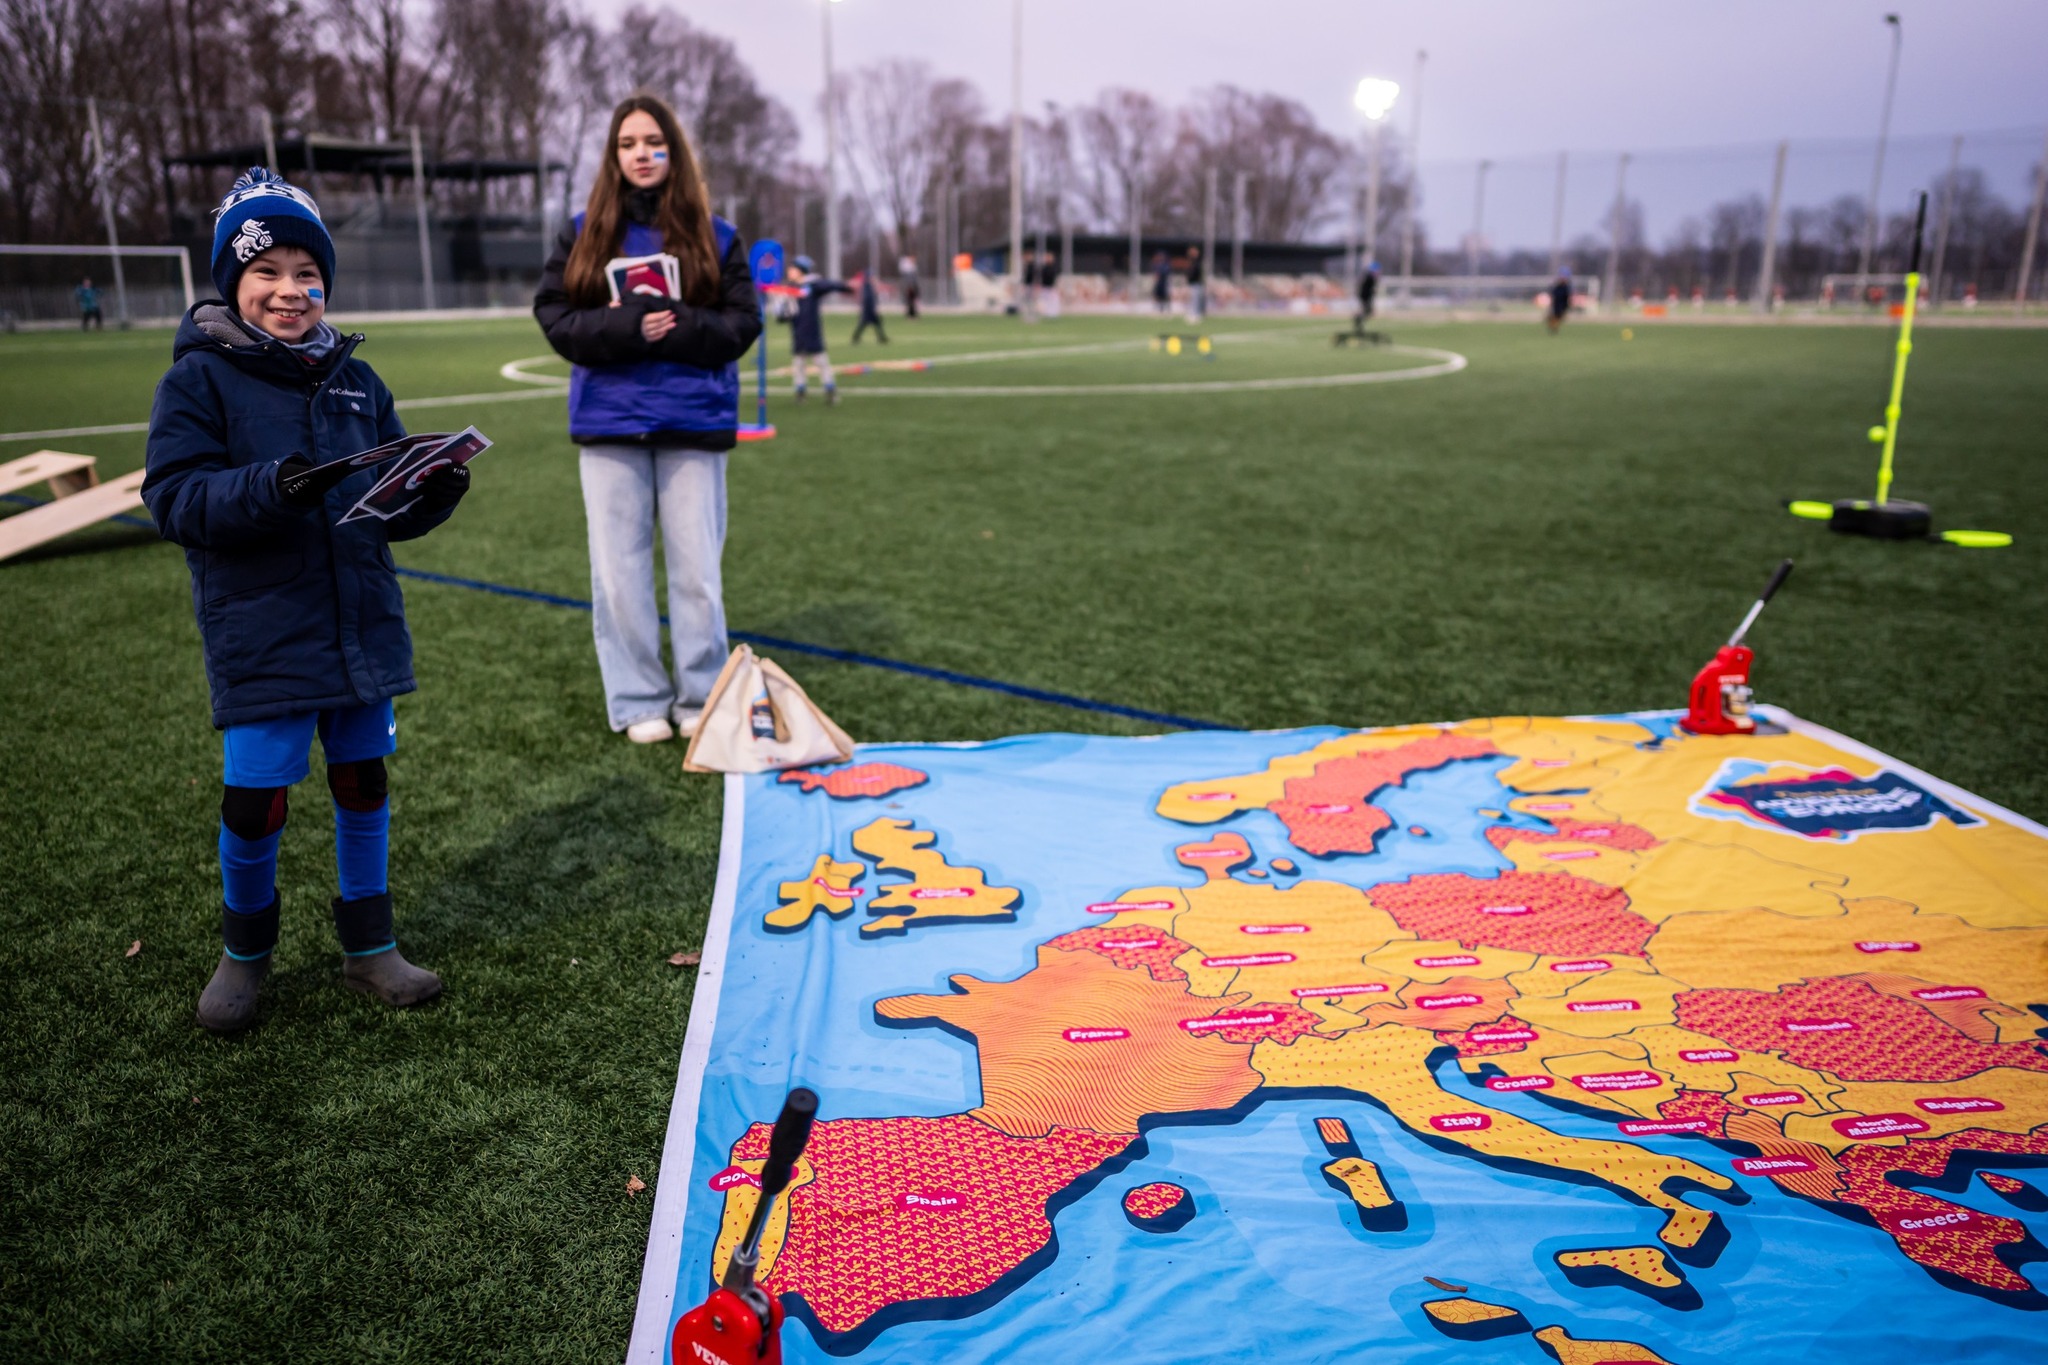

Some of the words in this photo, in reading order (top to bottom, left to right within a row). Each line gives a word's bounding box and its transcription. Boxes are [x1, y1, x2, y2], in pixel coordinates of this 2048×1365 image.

[336, 388, 366, 398] Columbia
[1207, 953, 1292, 967] Luxembourg
[1420, 956, 1476, 966] Czechia
[1556, 961, 1608, 971] Slovakia
[1297, 984, 1384, 996] Liechtenstein
[1424, 995, 1477, 1007] Austria
[1573, 1001, 1632, 1012] Hungary
[1187, 1014, 1275, 1029] Switzerland
[1070, 1029, 1124, 1041] France
[1473, 1030, 1532, 1042] Slovenia
[1686, 1050, 1732, 1060] Serbia
[1493, 1077, 1548, 1089] Croatia
[1581, 1077, 1658, 1090] Herzegovina
[1582, 1074, 1625, 1083] Bosnia
[1628, 1072, 1648, 1081] and
[1750, 1094, 1798, 1106] Kosovo
[1924, 1099, 1995, 1111] Bulgaria
[1441, 1114, 1482, 1128] Italy
[1626, 1119, 1708, 1133] Montenegro
[1856, 1117, 1896, 1128] North
[1849, 1121, 1922, 1137] Macedonia
[1744, 1157, 1808, 1171] Albania
[906, 1195, 958, 1207] Spain
[1899, 1212, 1970, 1230] Greece
